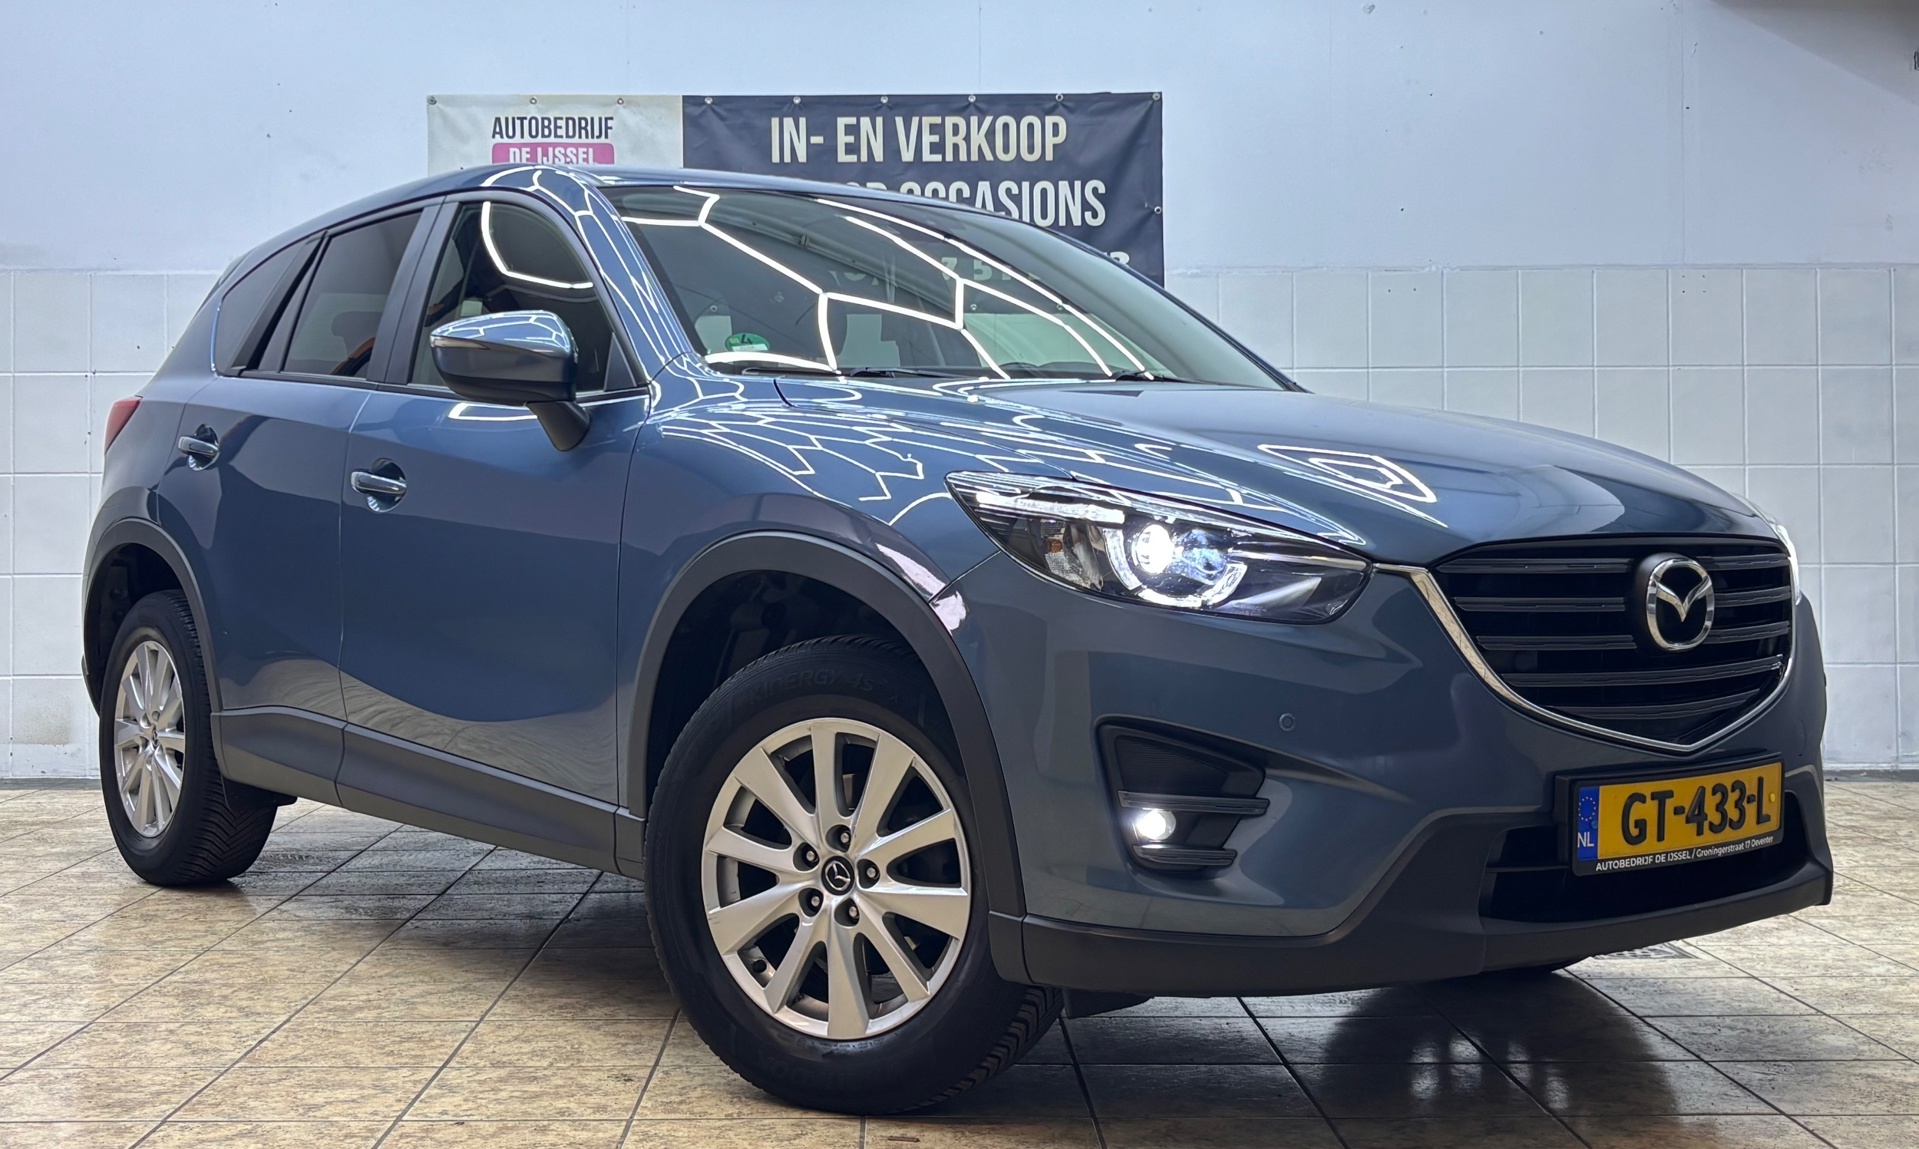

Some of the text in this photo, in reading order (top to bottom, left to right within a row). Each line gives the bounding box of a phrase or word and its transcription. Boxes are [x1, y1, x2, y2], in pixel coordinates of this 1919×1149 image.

[492, 116, 614, 139] AUTOBEDRIJF
[771, 115, 1067, 163] IN- EN VERKOOP
[509, 147, 594, 165] DE IJSSEL
[900, 179, 1106, 227] ASIONS
[1621, 776, 1771, 845] GT-433-L
[1577, 832, 1594, 848] NL
[1595, 855, 1653, 872] AUTOBEDRIJF
[1655, 854, 1666, 863] DE
[1667, 851, 1691, 862] IJSSEL
[1696, 842, 1744, 859] Groningerstraat
[1744, 840, 1751, 849] 17
[1751, 836, 1774, 848] Deventer
